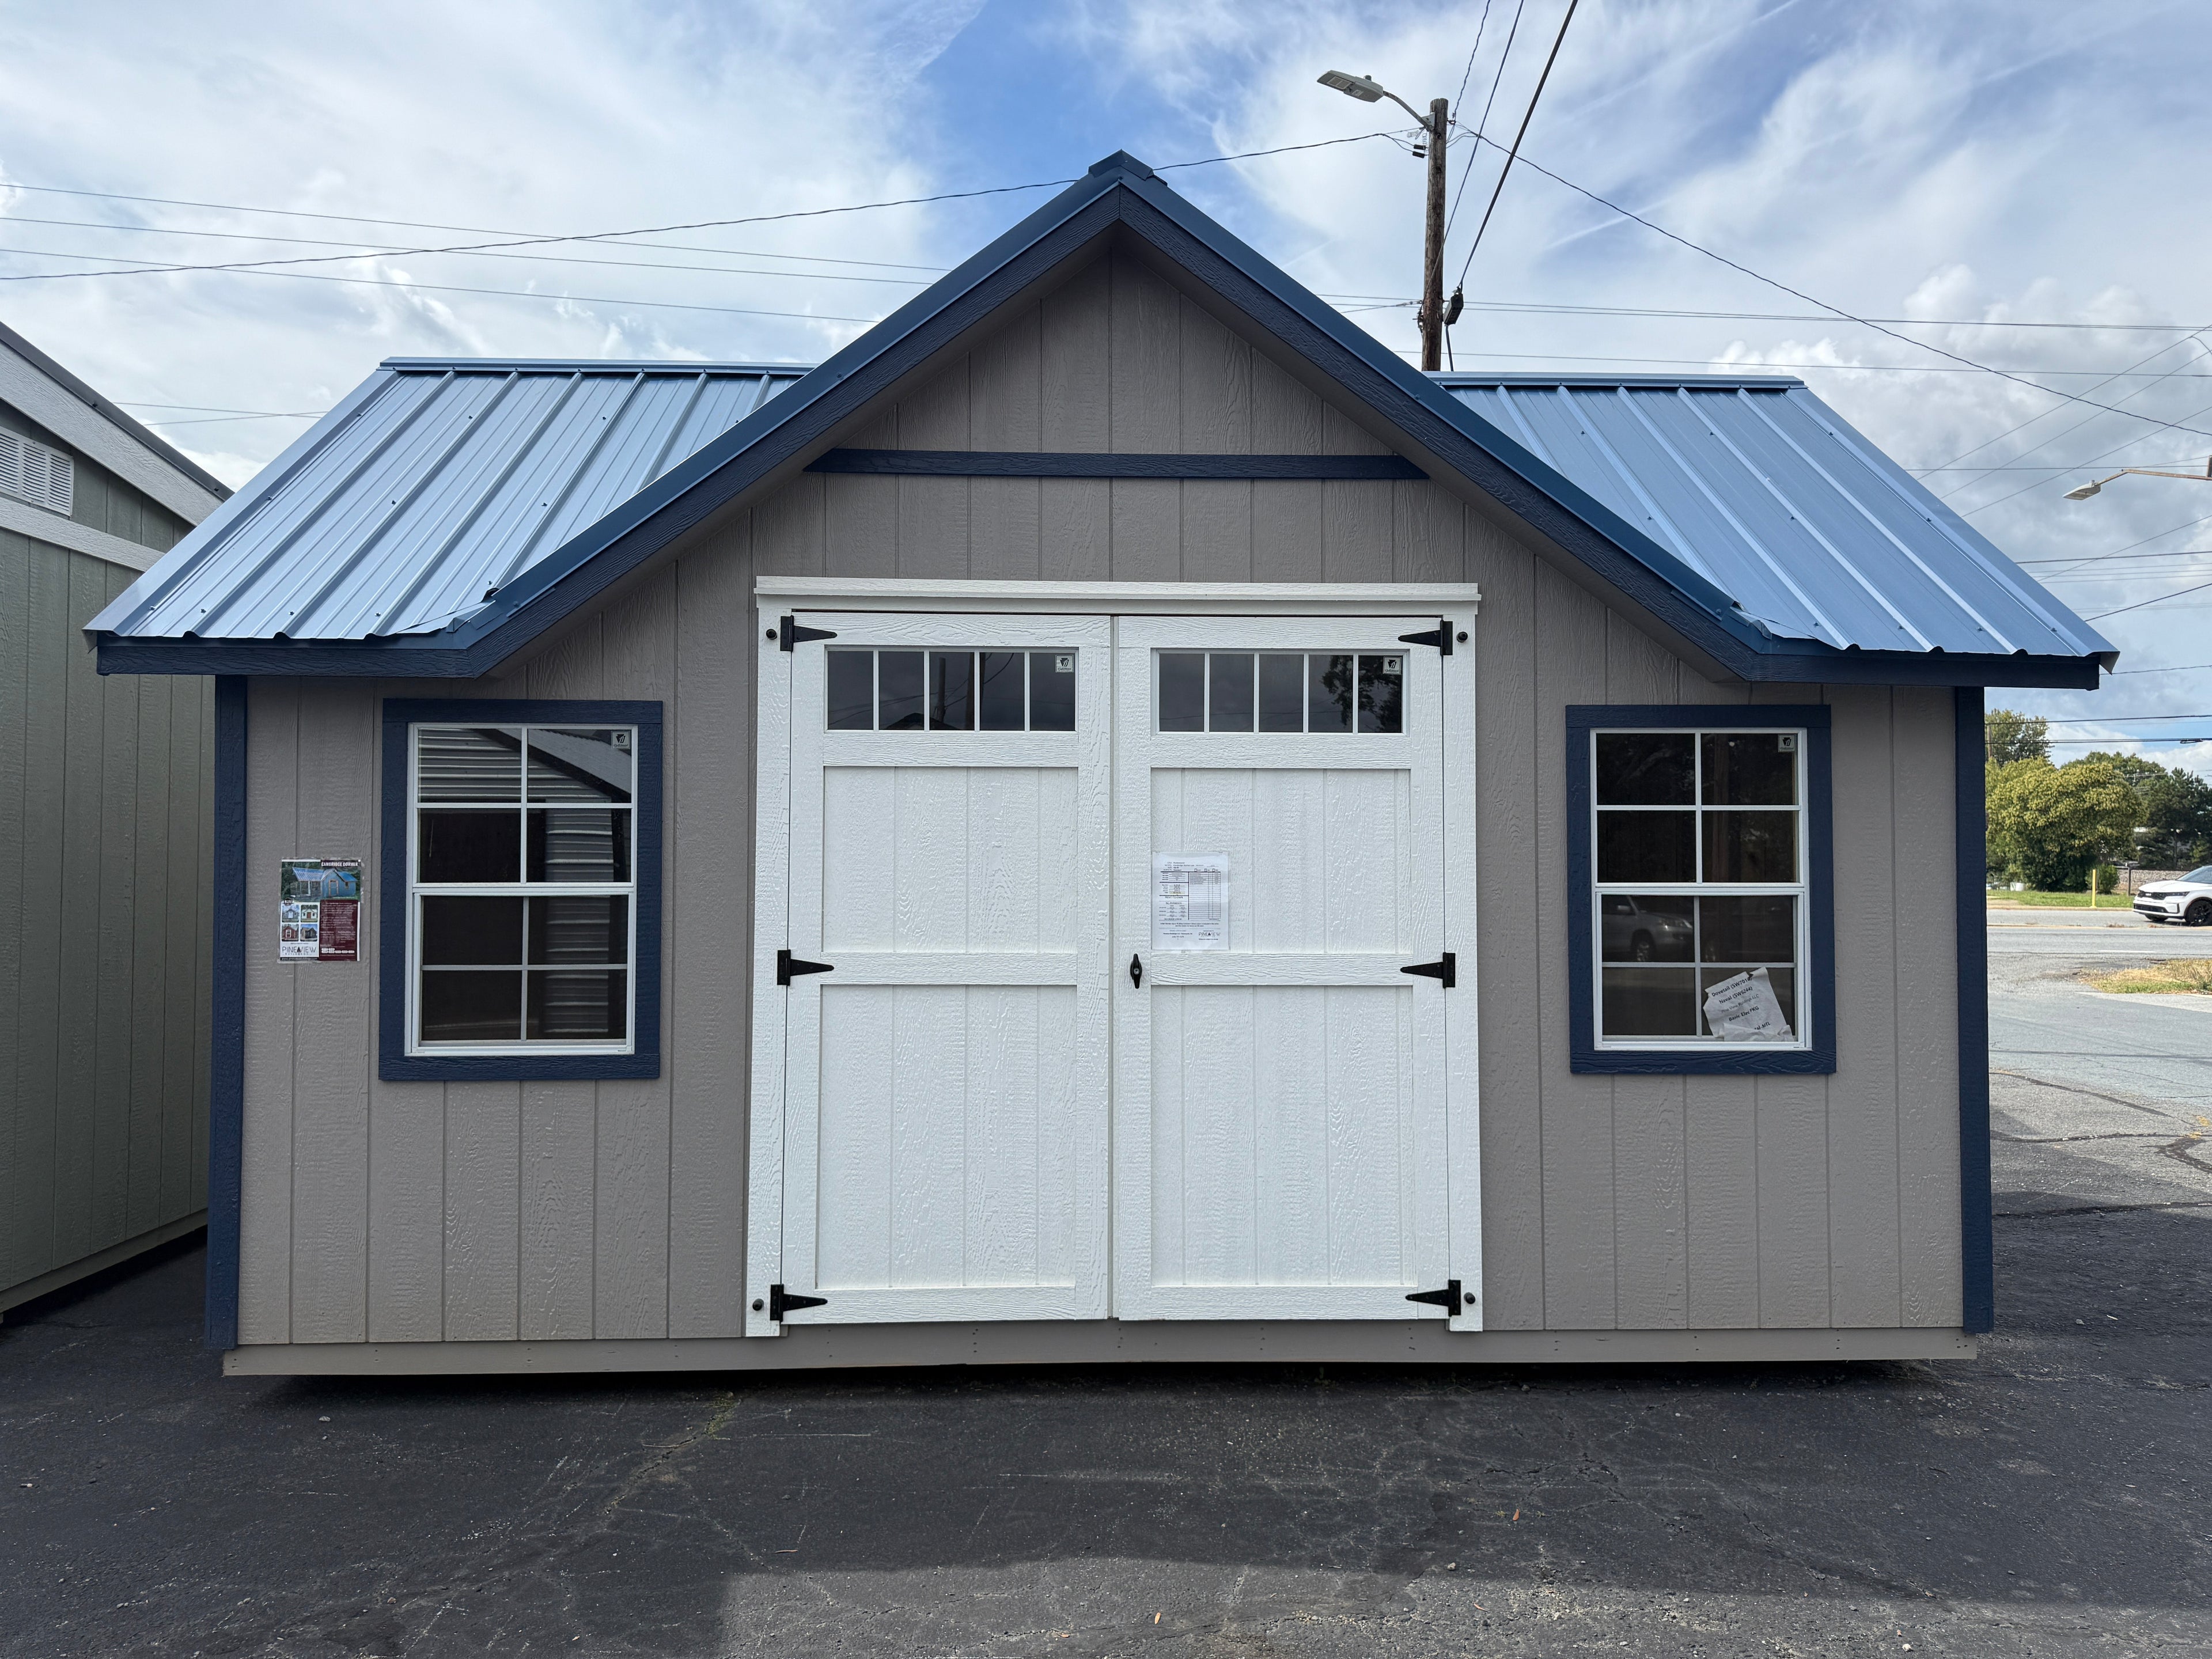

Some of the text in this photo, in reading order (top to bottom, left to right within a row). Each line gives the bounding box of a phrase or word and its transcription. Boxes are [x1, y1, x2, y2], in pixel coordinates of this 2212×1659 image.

[1711, 986, 1730, 997] Dovetail
[1719, 986, 1753, 1004] Naval (SW6244)
